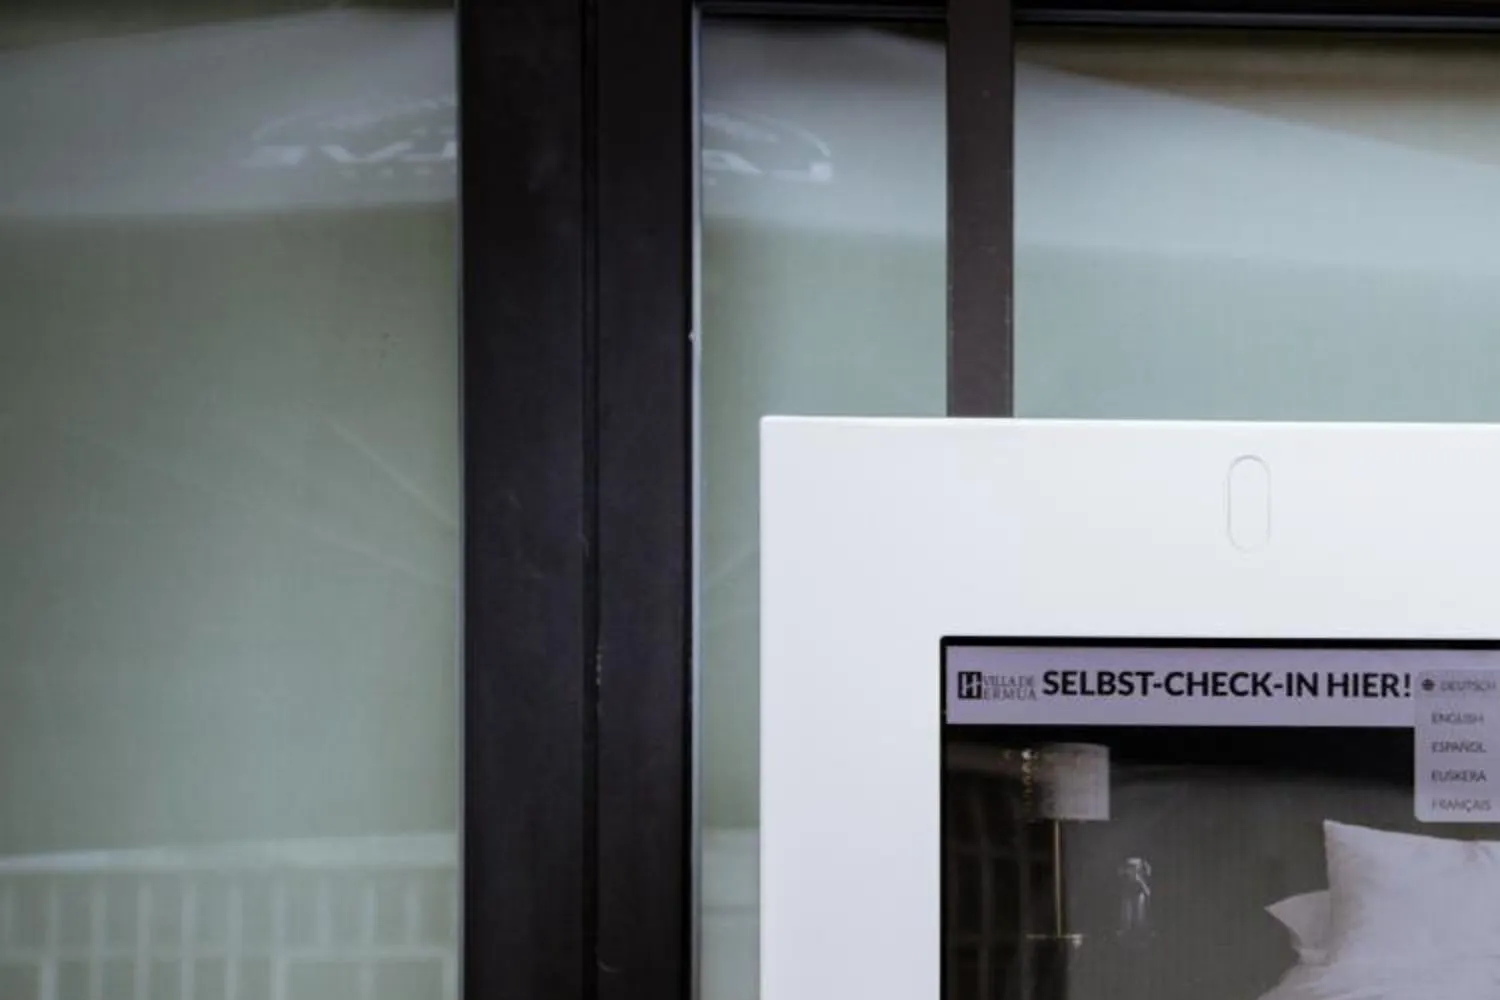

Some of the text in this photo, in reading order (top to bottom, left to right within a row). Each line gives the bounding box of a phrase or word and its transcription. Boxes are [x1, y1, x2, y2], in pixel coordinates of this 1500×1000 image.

[1042, 670, 1413, 698] SELBST-CHECK-IN HIER!
[1440, 679, 1498, 692] DEUTSCH
[1431, 711, 1485, 725] ENGLISH
[1431, 738, 1488, 754] ESPAÑOL
[1431, 769, 1488, 782] EUSKERA
[1431, 798, 1493, 814] FRANÇAIS
